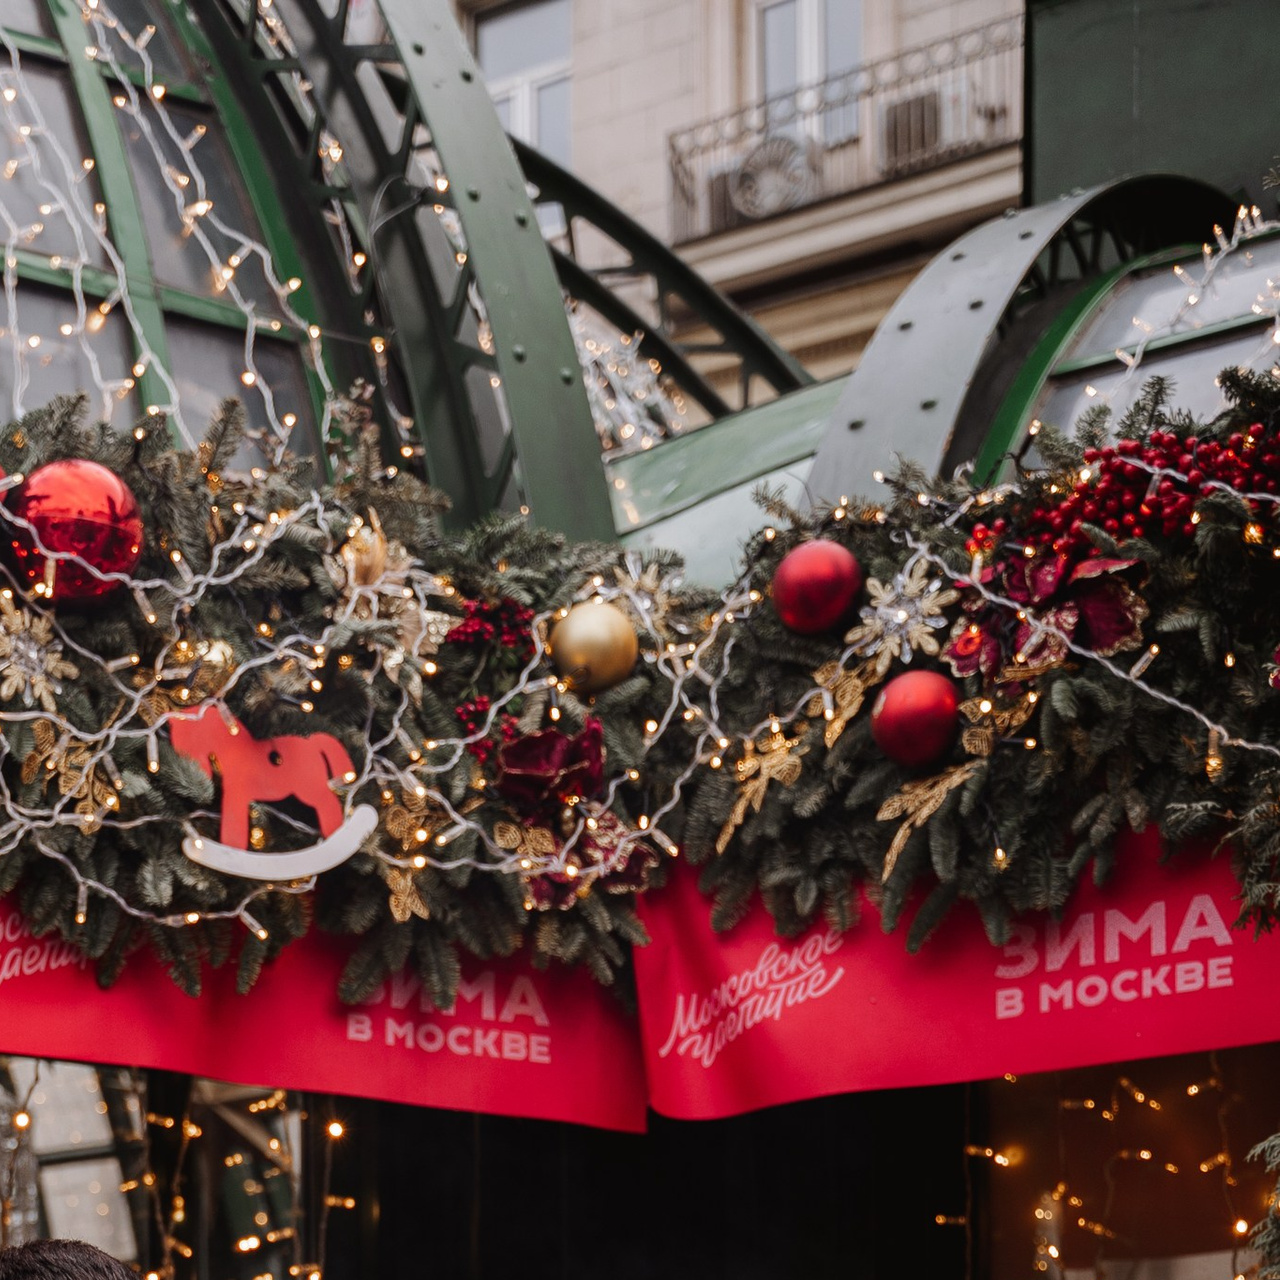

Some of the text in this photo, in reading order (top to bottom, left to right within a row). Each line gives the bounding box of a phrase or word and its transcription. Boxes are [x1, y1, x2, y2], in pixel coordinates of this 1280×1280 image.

[993, 894, 1233, 980] ЗИМА
[658, 929, 845, 1059] Московское
[995, 955, 1234, 1020] В МОСКВЕ
[346, 1012, 552, 1064] В МОСКВЕ
